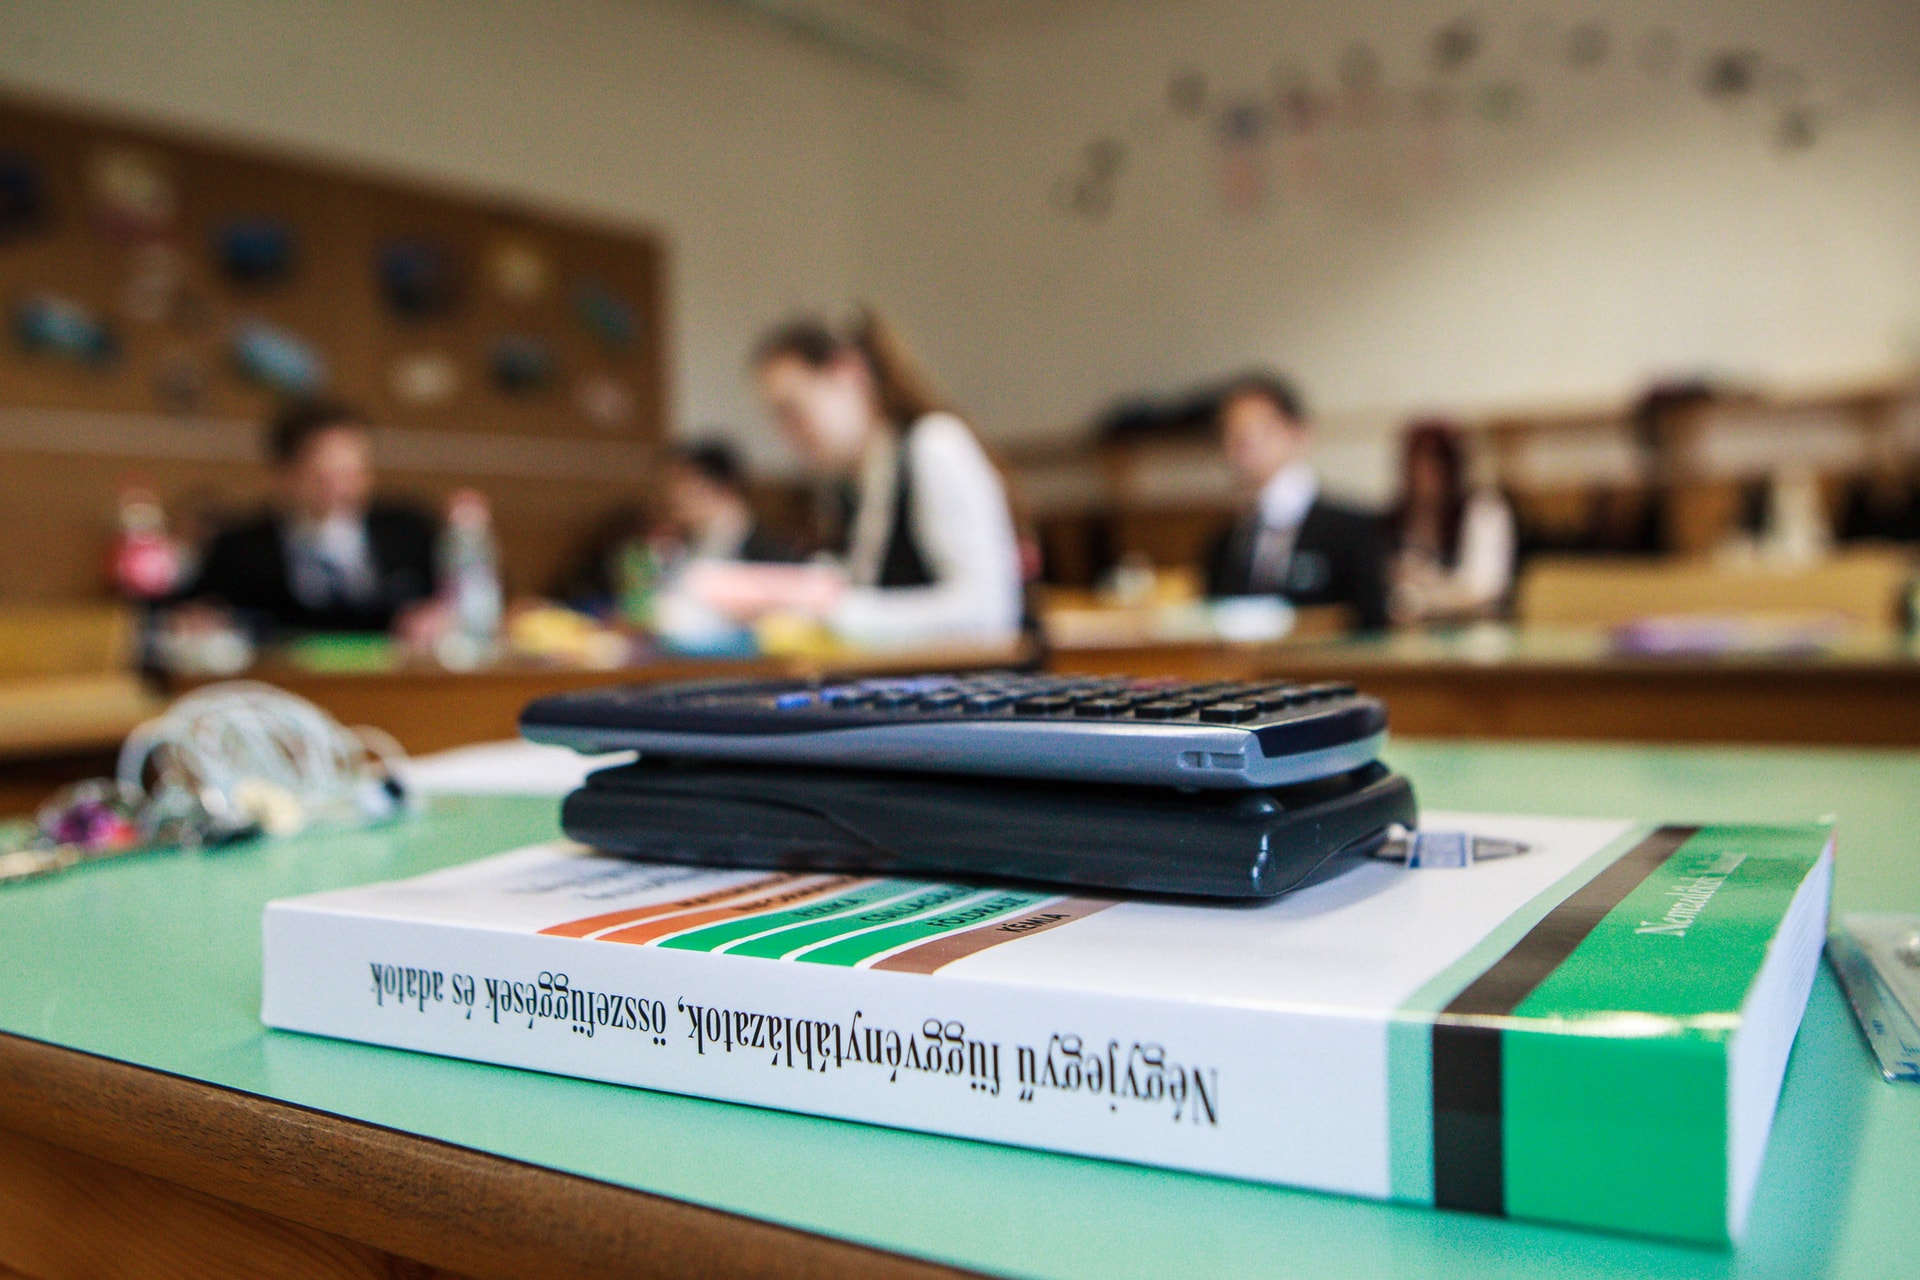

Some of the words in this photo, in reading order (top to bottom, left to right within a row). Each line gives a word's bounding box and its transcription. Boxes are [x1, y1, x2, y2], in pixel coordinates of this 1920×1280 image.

[996, 913, 1071, 934] KÉMIA
[369, 962, 444, 1014] adatok
[451, 973, 476, 1021] és
[484, 970, 667, 1047] összefüggések
[677, 996, 1000, 1096] függvénytáblázatok,
[1017, 1033, 1218, 1125] Négyjegyű
